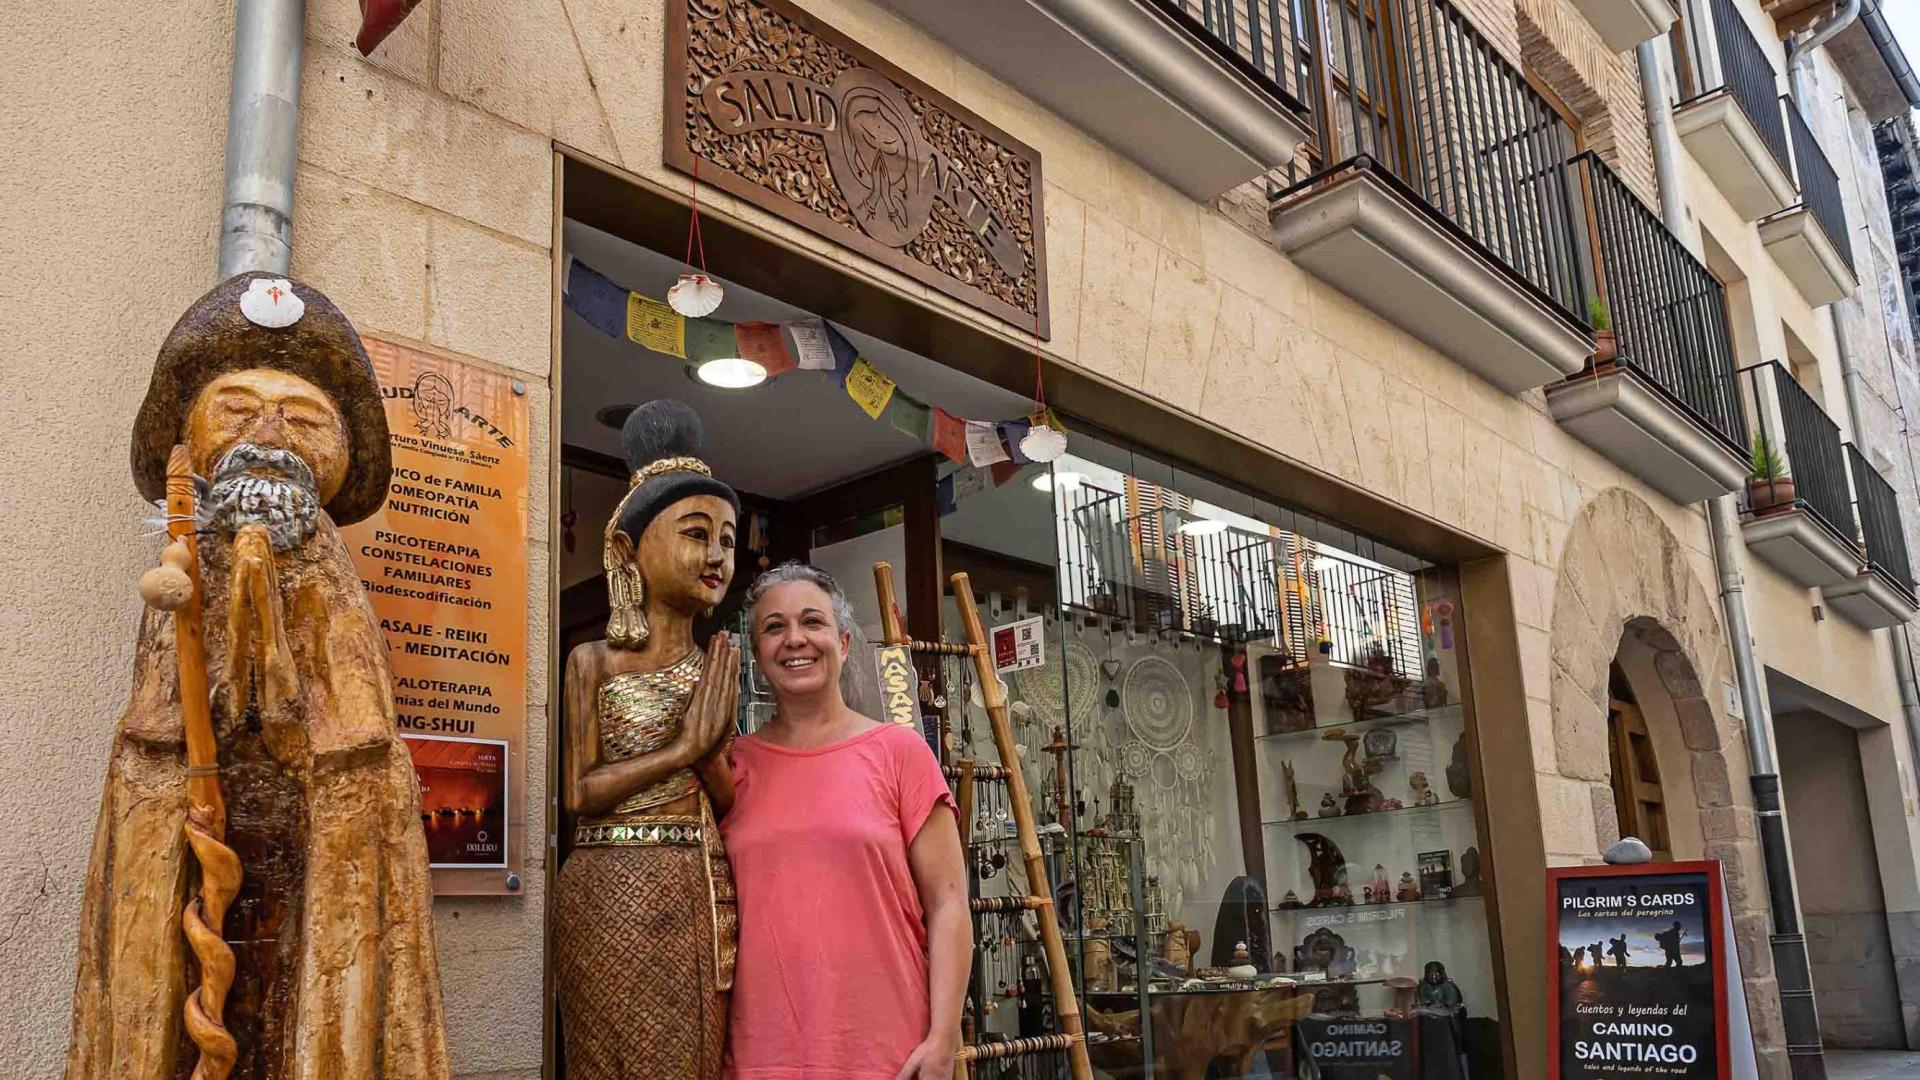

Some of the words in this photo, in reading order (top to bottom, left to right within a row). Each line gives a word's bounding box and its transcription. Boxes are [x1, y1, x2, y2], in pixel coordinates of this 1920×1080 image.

[716, 79, 839, 132] SALUD
[920, 152, 1004, 248] ARTE
[381, 386, 415, 399] UD
[453, 406, 514, 448] ARTE
[388, 433, 418, 446] rturo
[421, 439, 464, 457] Vinuesa
[393, 467, 421, 482] ICO
[424, 474, 441, 486] de
[445, 478, 502, 500] FAMILIA
[390, 483, 480, 511] OMEOPATÍA
[388, 499, 470, 525] NUTRICIÓN
[375, 530, 481, 559] PSICOTERAPIA
[361, 545, 493, 577] CONSTELACIONES
[384, 566, 472, 590] FAMILIARES
[361, 579, 492, 610] Biodescodificación
[380, 618, 433, 637] ASAJE
[445, 627, 488, 645] REIKI
[405, 641, 510, 666] MEDITACIÓN
[394, 676, 492, 697] ALOTERAPIA
[428, 697, 449, 710] del
[453, 699, 500, 715] Mundo
[396, 713, 475, 734] NG-SHUI
[1640, 892, 1695, 907] CARDS
[1621, 908, 1633, 916] del
[1636, 907, 1674, 918] peregrino
[1576, 1002, 1613, 1014] Cuentos
[1617, 1006, 1624, 1017] y
[1628, 1003, 1668, 1018] leyendas
[1672, 1003, 1688, 1016] del
[1592, 1021, 1673, 1037] CAMINO
[1574, 1041, 1698, 1064] SANTIAGO
[1602, 1063, 1615, 1071] and
[1617, 1064, 1642, 1073] legends
[1655, 1066, 1668, 1074] the
[1670, 1066, 1688, 1074] road
